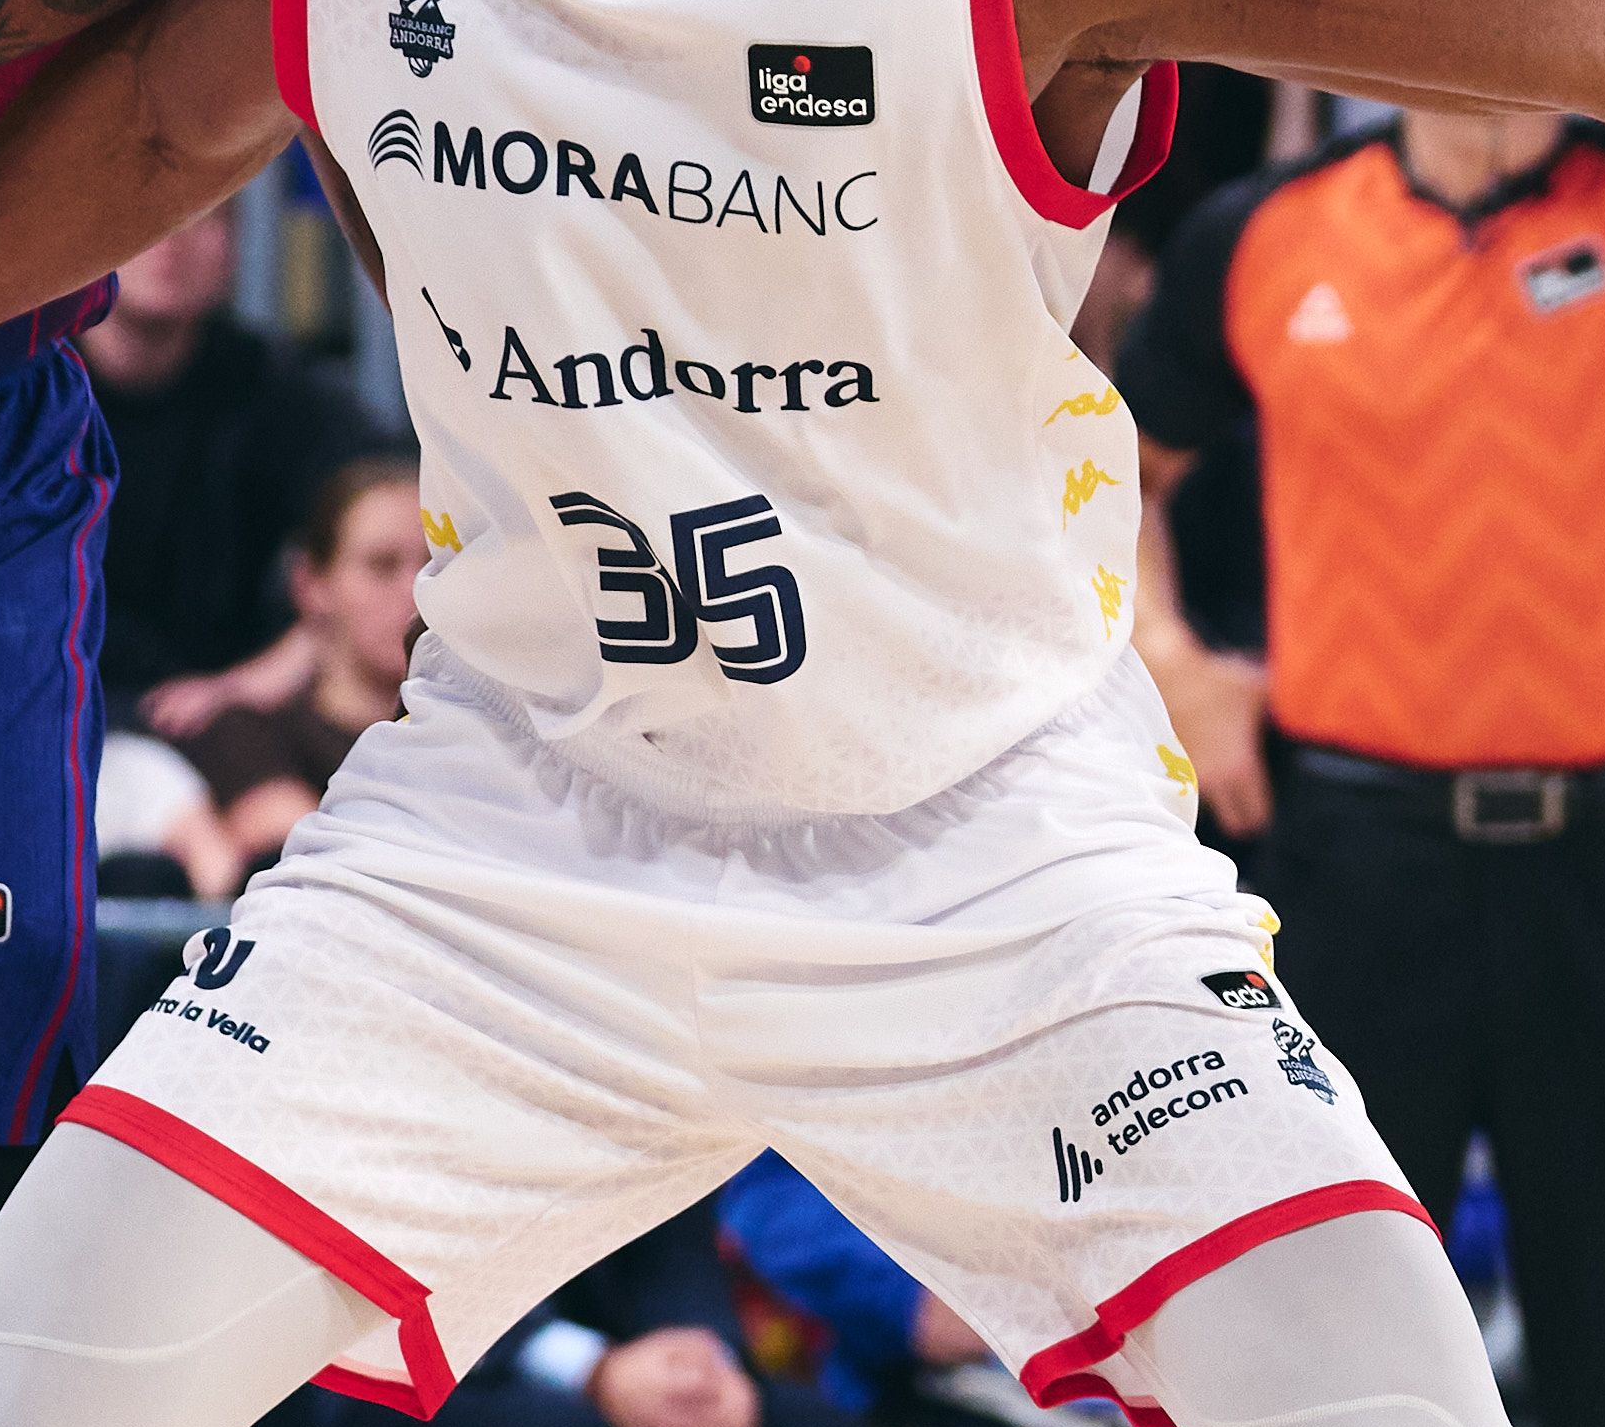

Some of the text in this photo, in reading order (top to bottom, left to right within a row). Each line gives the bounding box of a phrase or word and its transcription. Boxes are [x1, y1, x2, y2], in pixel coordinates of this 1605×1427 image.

[390, 14, 453, 35] MORABANC
[391, 29, 451, 54] ANDORRA
[758, 67, 807, 94] liga
[760, 93, 868, 117] endesa
[432, 120, 880, 237] MORABANC
[489, 327, 881, 415] Andorra
[549, 489, 808, 685] 35
[1222, 984, 1270, 1008] acb
[207, 1008, 271, 1054] Vella
[1091, 1050, 1227, 1126] andorra
[1107, 1077, 1249, 1156] telecom
